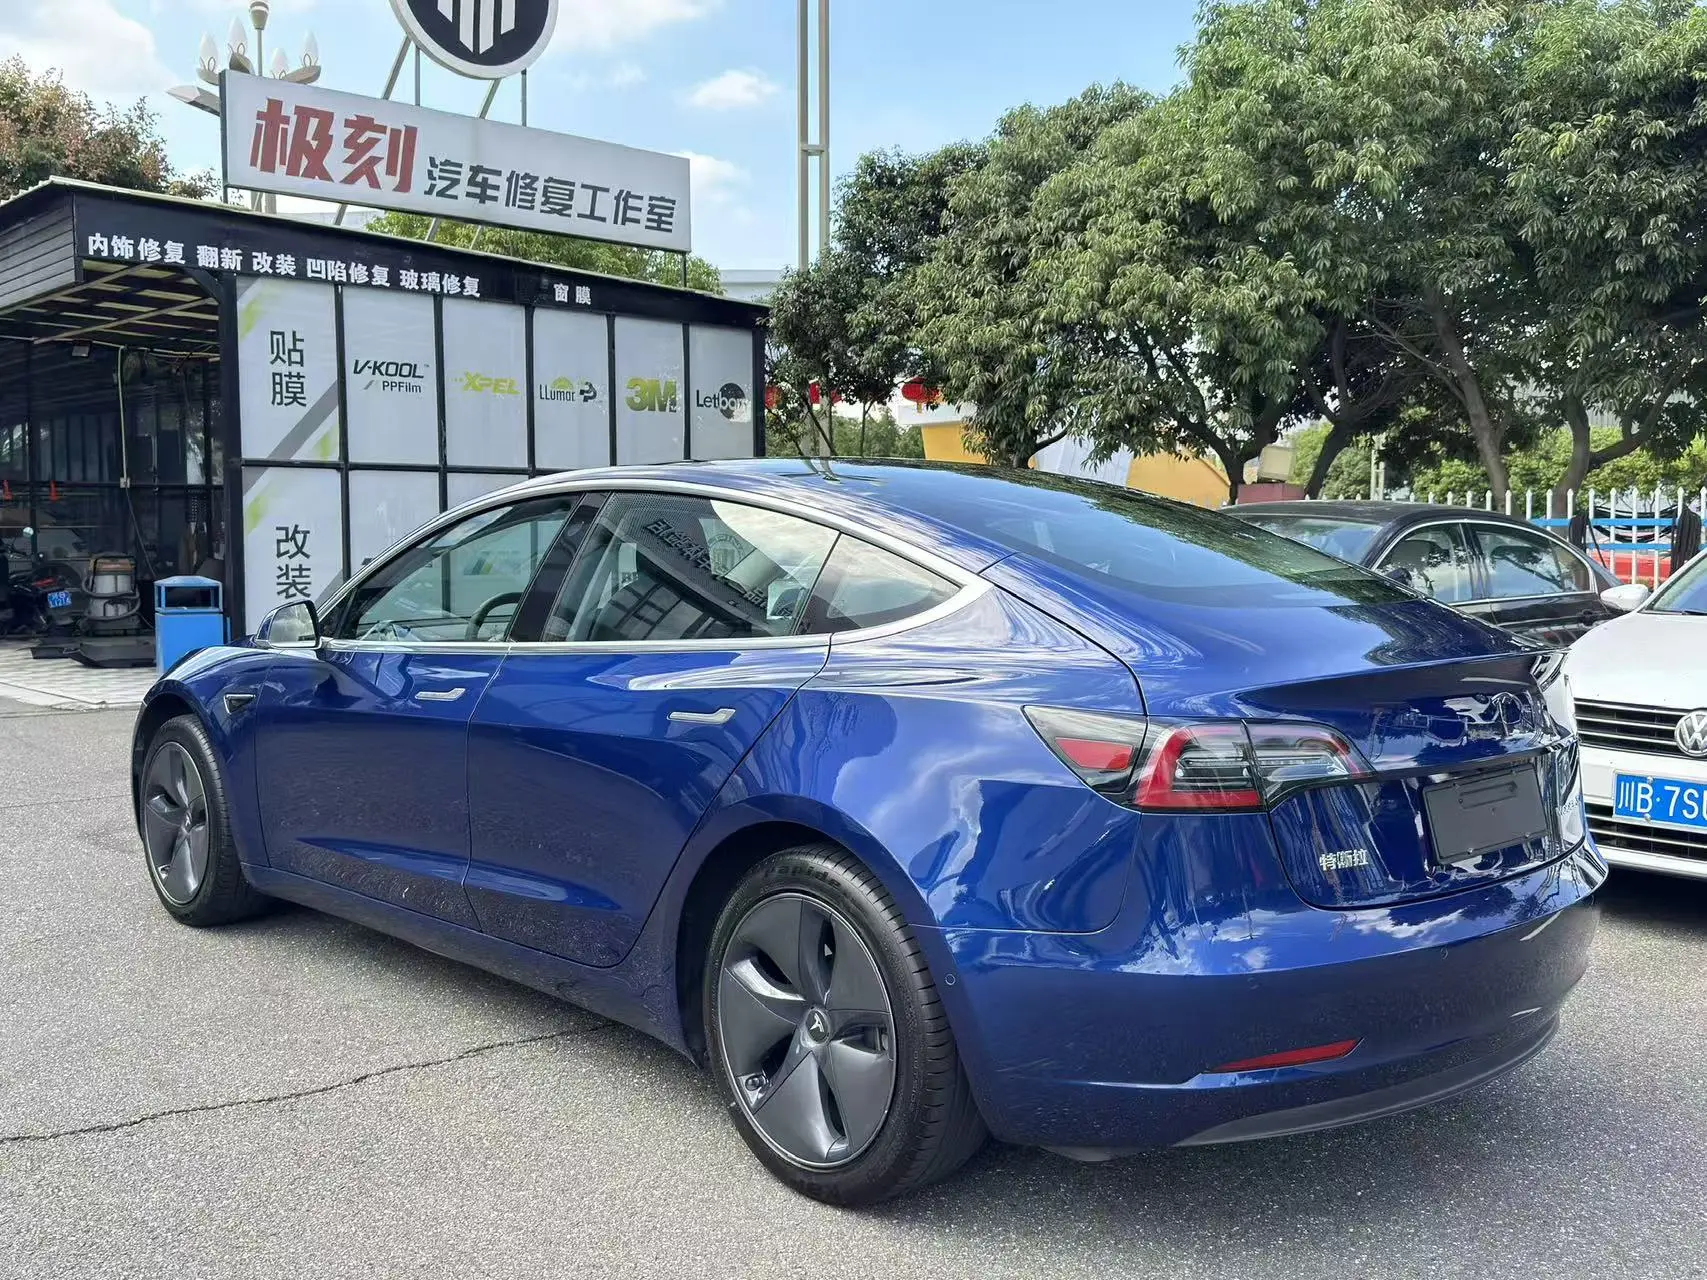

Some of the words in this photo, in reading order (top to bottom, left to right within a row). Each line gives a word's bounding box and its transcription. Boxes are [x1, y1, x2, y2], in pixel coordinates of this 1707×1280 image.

[250, 98, 418, 193] 极刻
[424, 156, 676, 233] 汽车修复工作室
[88, 232, 186, 264] 内饰修复
[196, 245, 243, 271] 翻新
[252, 251, 297, 276] 改装
[306, 257, 390, 288] 凹陷修复
[400, 269, 480, 298] 玻璃修复
[553, 283, 592, 305] 窗膜
[270, 330, 307, 407] 贴膜
[353, 359, 424, 378] V-KOOL
[463, 371, 520, 395] XPEL
[382, 381, 422, 393] PPFilm
[625, 378, 677, 413] 3M
[275, 524, 312, 599] 改装
[1319, 849, 1369, 871] 特斯拉
